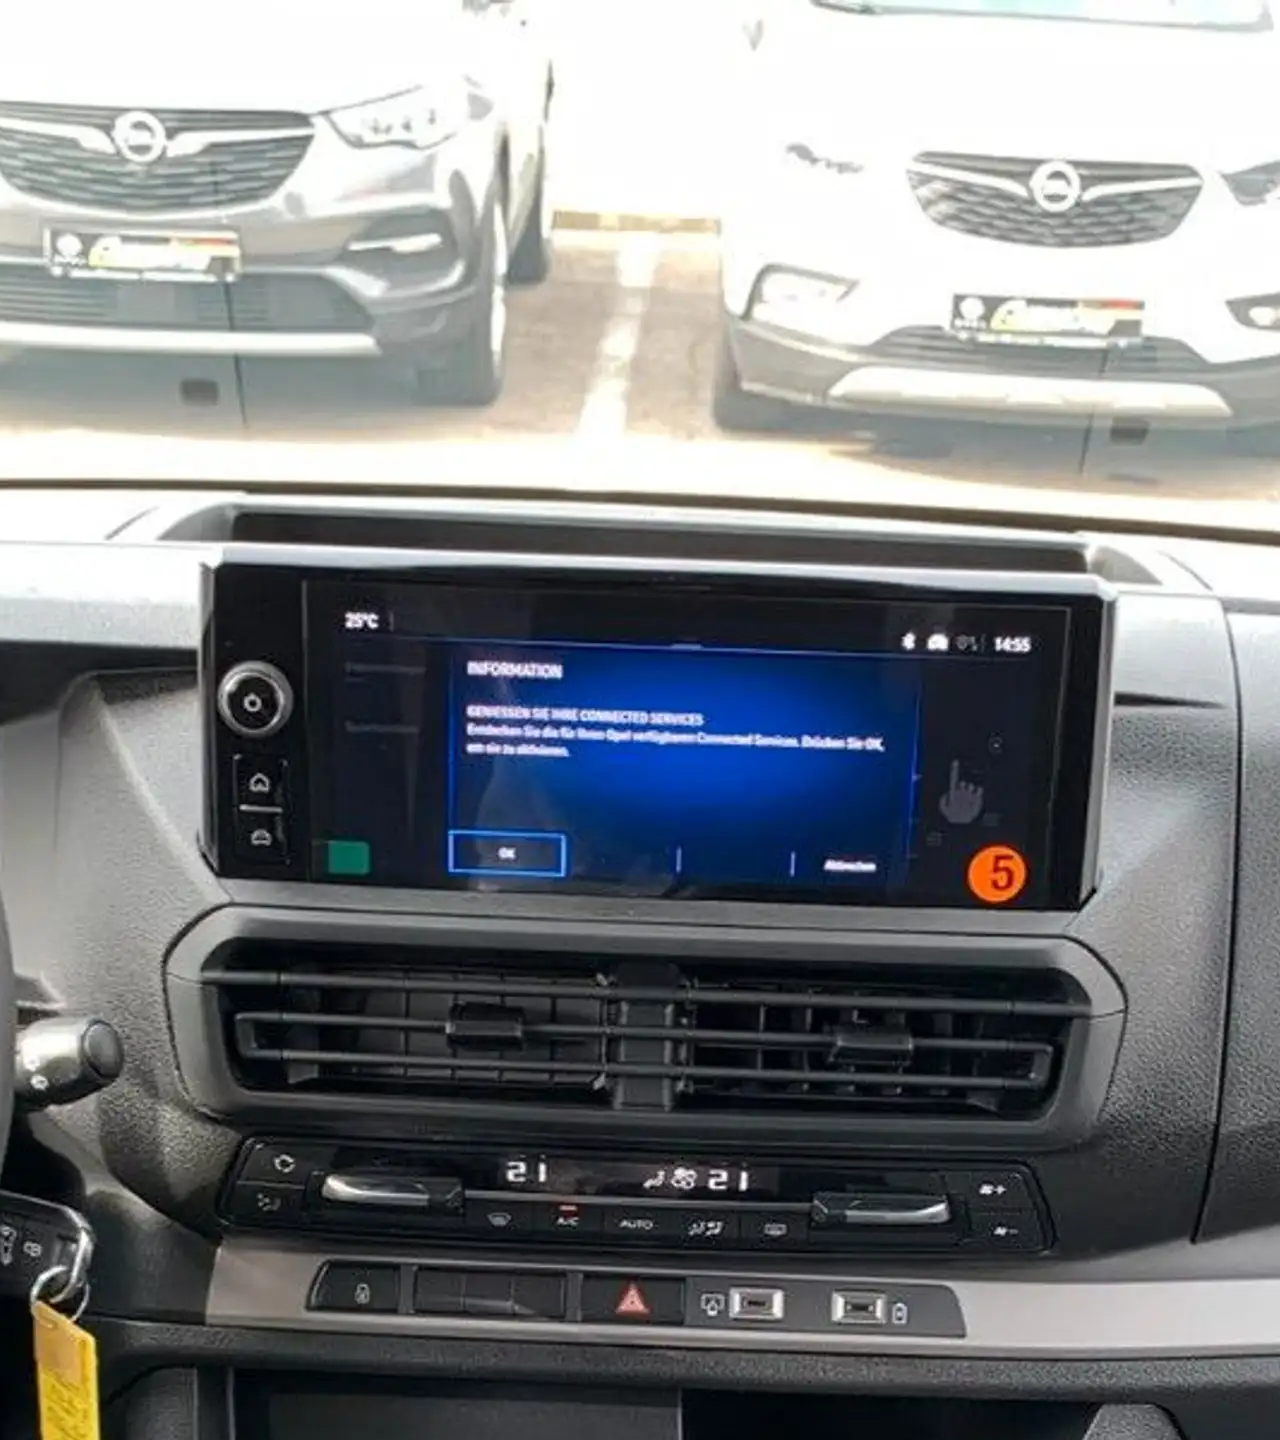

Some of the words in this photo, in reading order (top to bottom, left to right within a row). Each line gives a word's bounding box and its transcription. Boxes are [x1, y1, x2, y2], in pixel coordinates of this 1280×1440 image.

[994, 636, 1032, 653] 14:55
[467, 660, 564, 679] INFORMATION
[532, 707, 549, 720] SIE
[579, 709, 648, 724] CONNECTED
[649, 712, 704, 726] SERVICES
[524, 724, 540, 738] Sie
[606, 728, 632, 743] Opel
[498, 847, 516, 860] OK
[990, 853, 1015, 892] 5
[556, 1216, 580, 1228] A/C
[620, 1219, 654, 1231] AUTO
